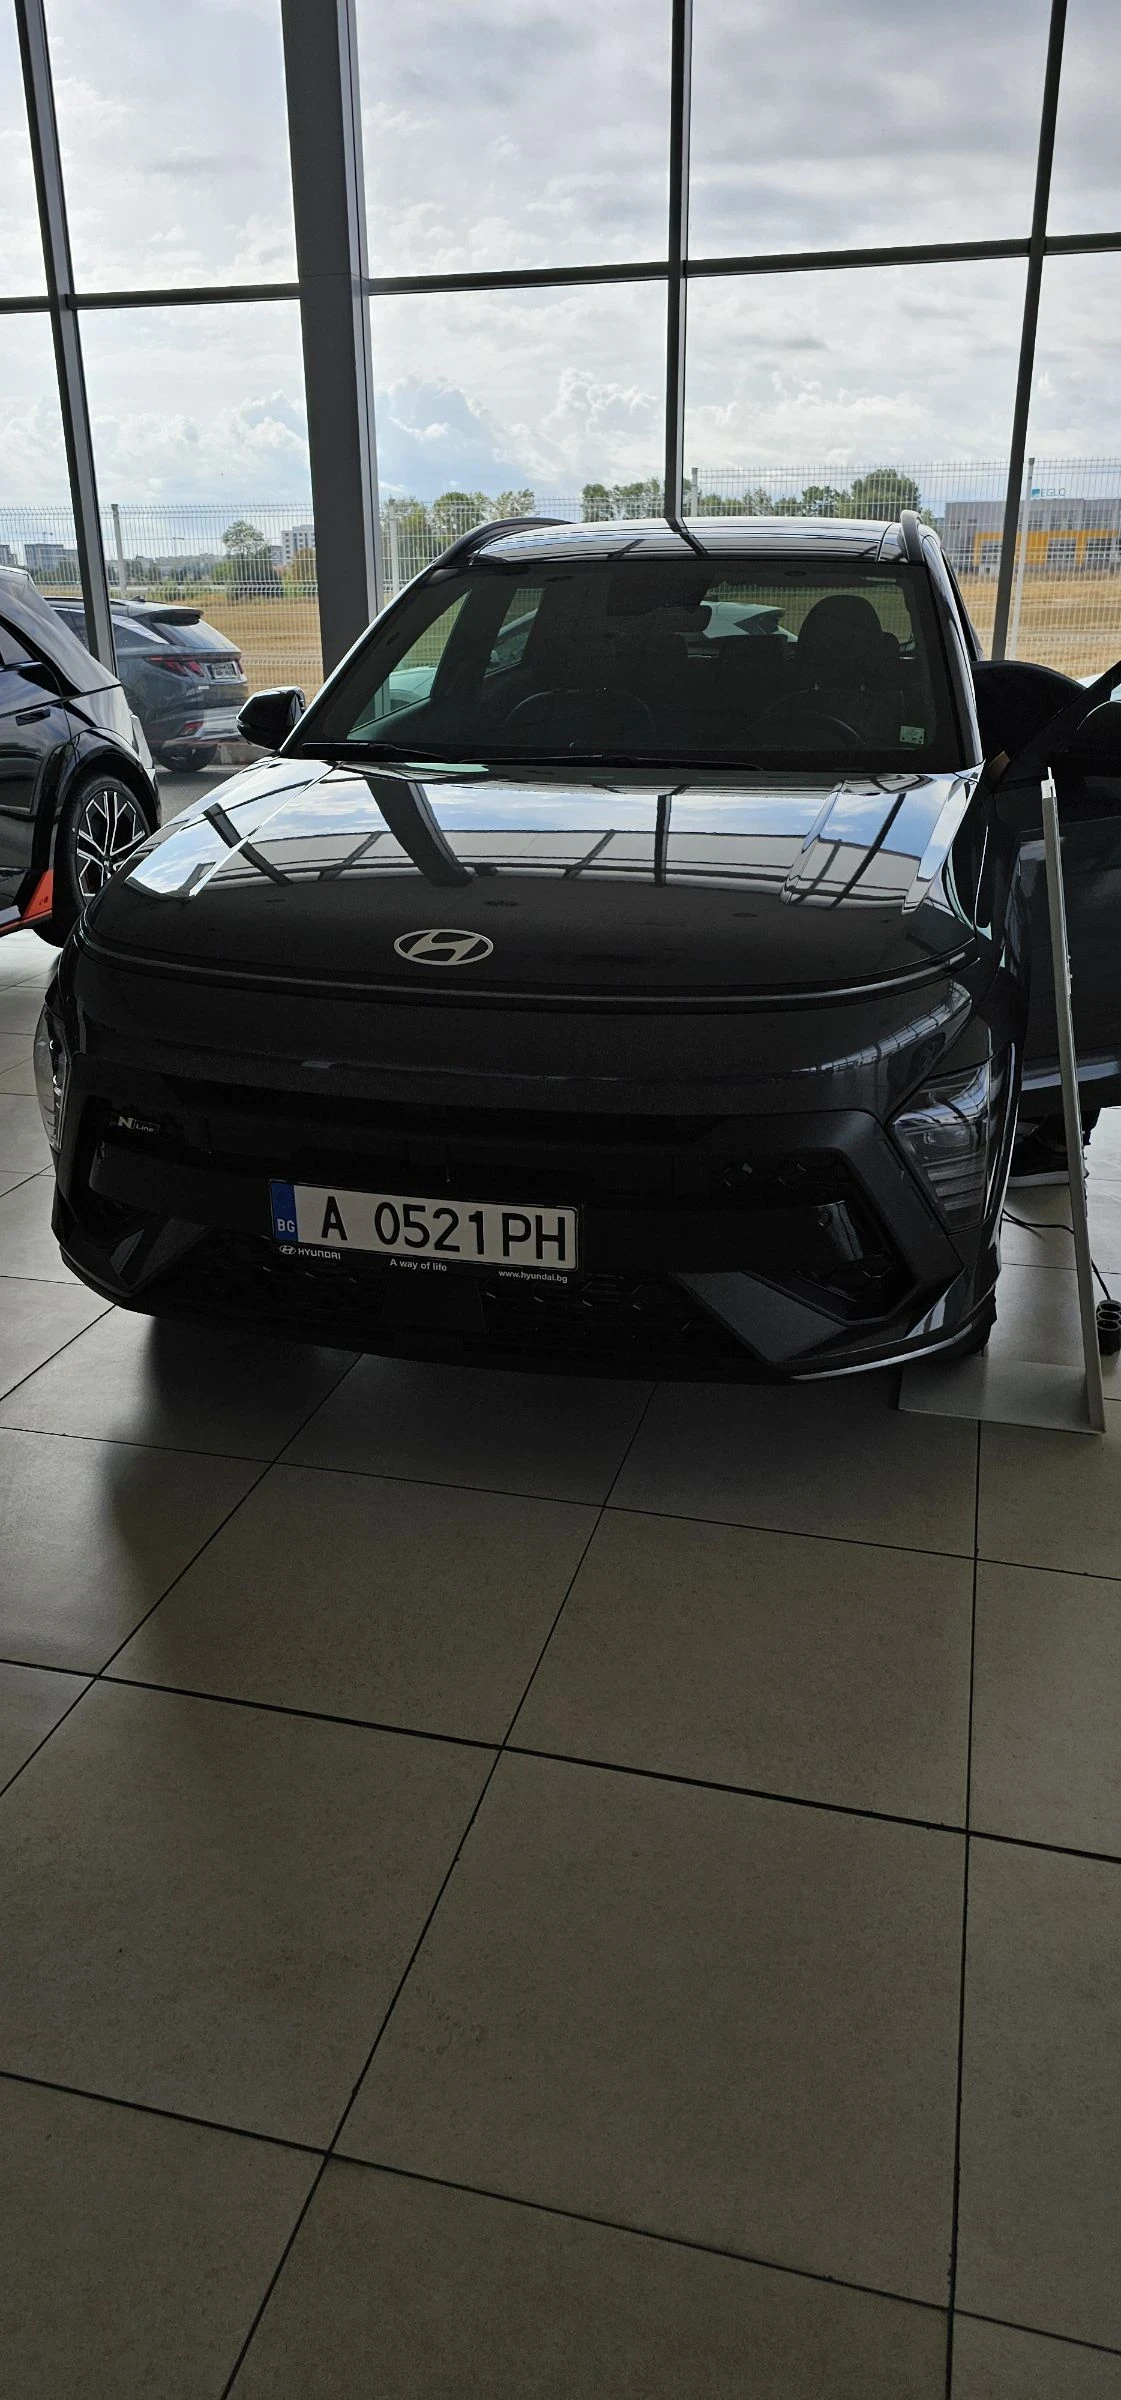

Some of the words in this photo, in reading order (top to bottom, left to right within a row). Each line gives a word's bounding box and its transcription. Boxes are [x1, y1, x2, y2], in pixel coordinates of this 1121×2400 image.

[118, 1116, 133, 1129] N
[277, 1219, 295, 1233] BG
[321, 1196, 348, 1241] A
[374, 1202, 485, 1255] 0521
[502, 1212, 565, 1261] PH
[298, 1248, 341, 1260] HYUNDAI
[390, 1259, 398, 1267] A
[400, 1260, 418, 1270] way
[420, 1261, 431, 1269] of
[432, 1262, 448, 1271] life
[498, 1270, 568, 1284] www.hyundai.bg
